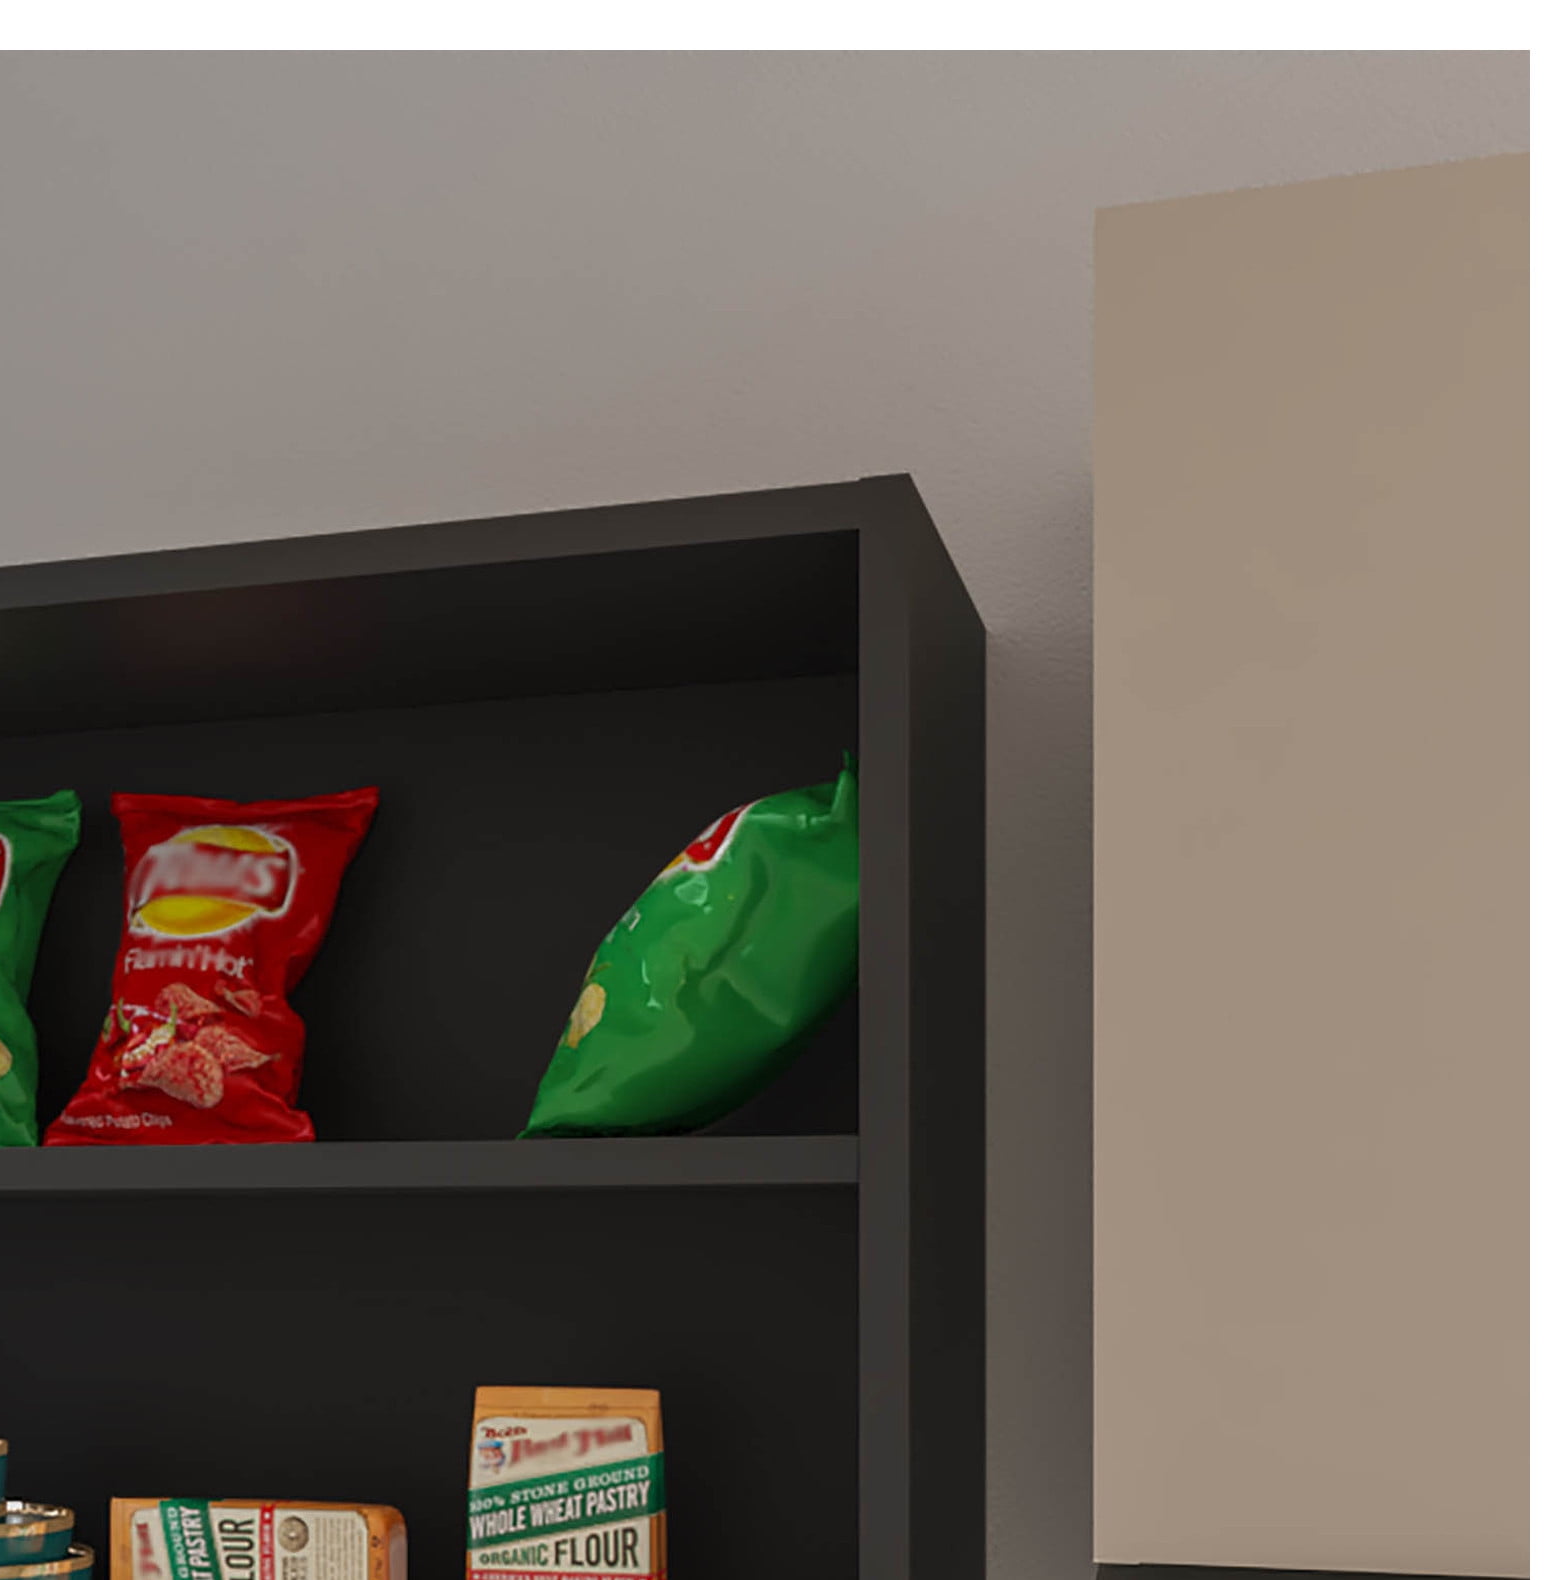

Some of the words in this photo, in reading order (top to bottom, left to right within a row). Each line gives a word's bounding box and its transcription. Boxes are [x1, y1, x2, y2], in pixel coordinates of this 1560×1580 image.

[468, 1505, 527, 1541] WHOLE
[530, 1493, 583, 1528] WHEAT
[585, 1480, 651, 1517] PASTRY
[510, 1478, 570, 1505] STONE
[573, 1465, 650, 1492] GROUND
[167, 1506, 189, 1578] GROUND
[179, 1505, 211, 1567] PASTRY
[479, 1542, 549, 1567] ORGANIC
[553, 1526, 639, 1569] FLOUR
